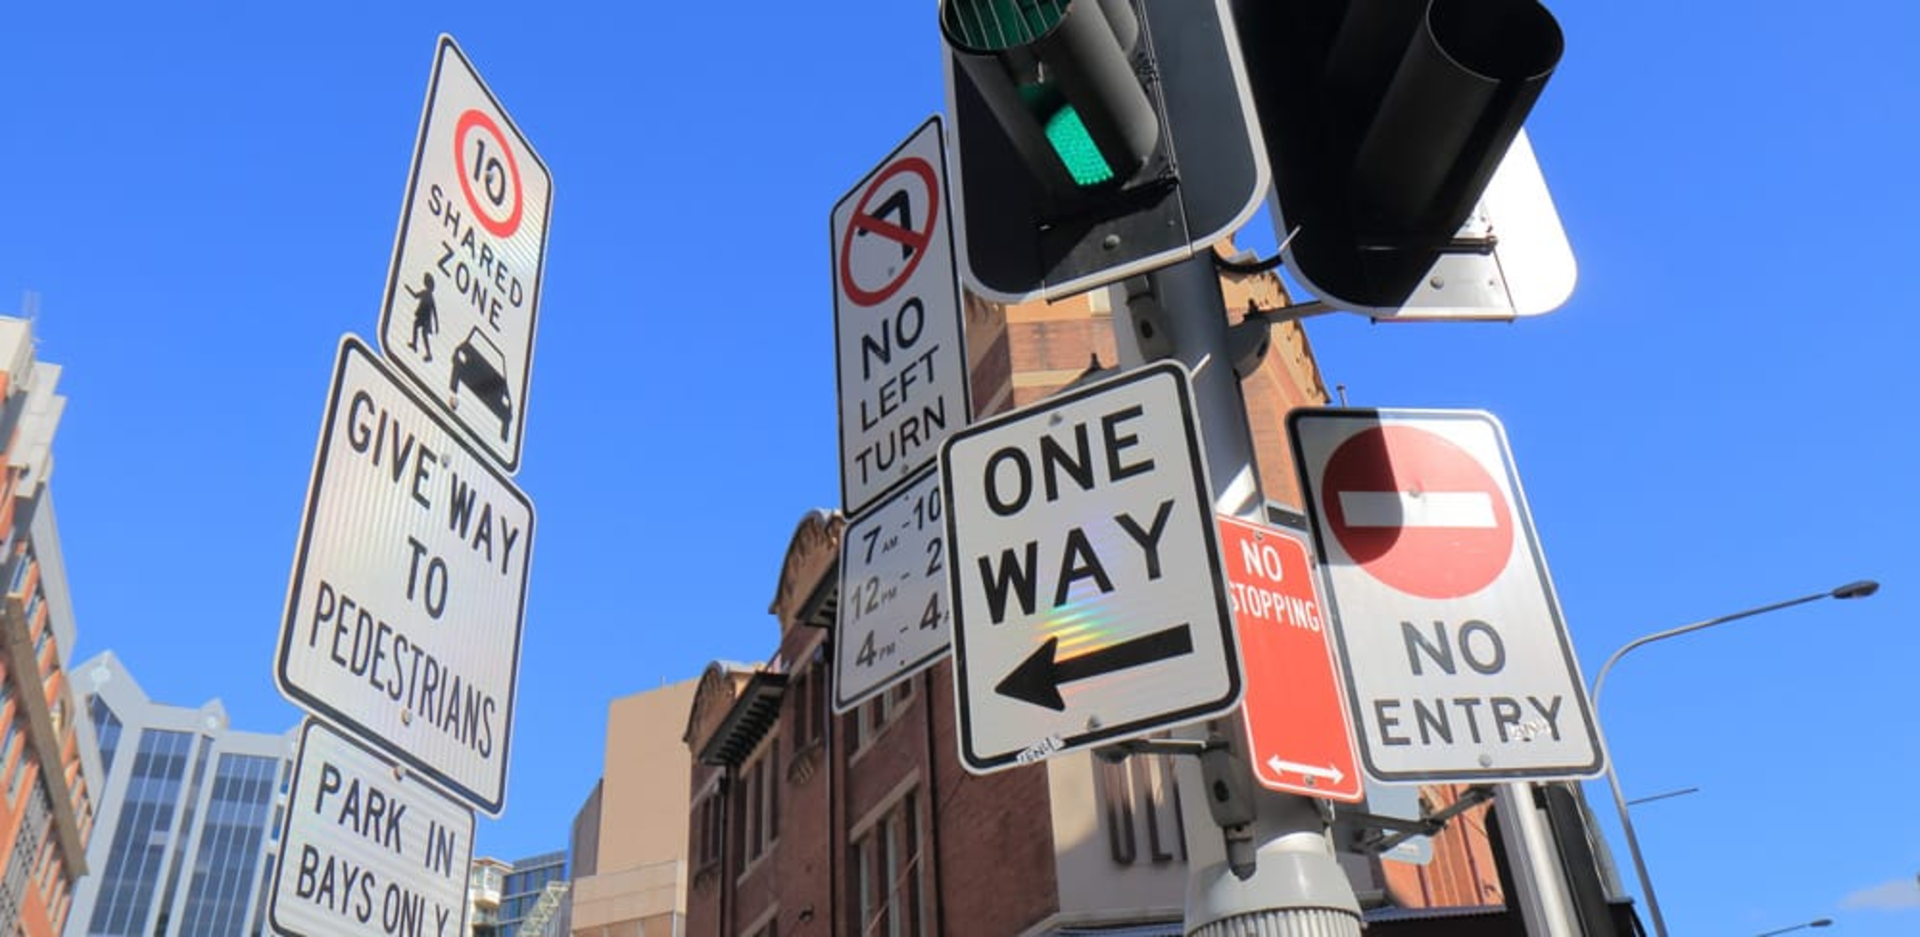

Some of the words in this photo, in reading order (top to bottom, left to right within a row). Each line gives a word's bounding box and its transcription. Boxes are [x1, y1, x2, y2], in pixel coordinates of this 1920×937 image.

[473, 138, 506, 207] 10
[428, 183, 523, 309] SHARED
[437, 240, 504, 333] ZONE
[861, 296, 925, 381] NO
[860, 344, 940, 433] LEFT
[347, 389, 438, 510] GIVE
[449, 471, 520, 576] WAY
[855, 395, 946, 485] TURN
[983, 404, 1156, 517] ONE
[406, 534, 450, 620] TO
[978, 499, 1176, 625] WAY
[1240, 538, 1283, 583] NO
[1229, 580, 1322, 633] STOPPING
[1400, 619, 1507, 677] NO
[308, 580, 496, 759] PEDESTRIANS
[1374, 695, 1563, 747] ENTRY
[315, 762, 407, 854] PARK
[424, 819, 456, 879] IN
[295, 843, 376, 924] BAYS
